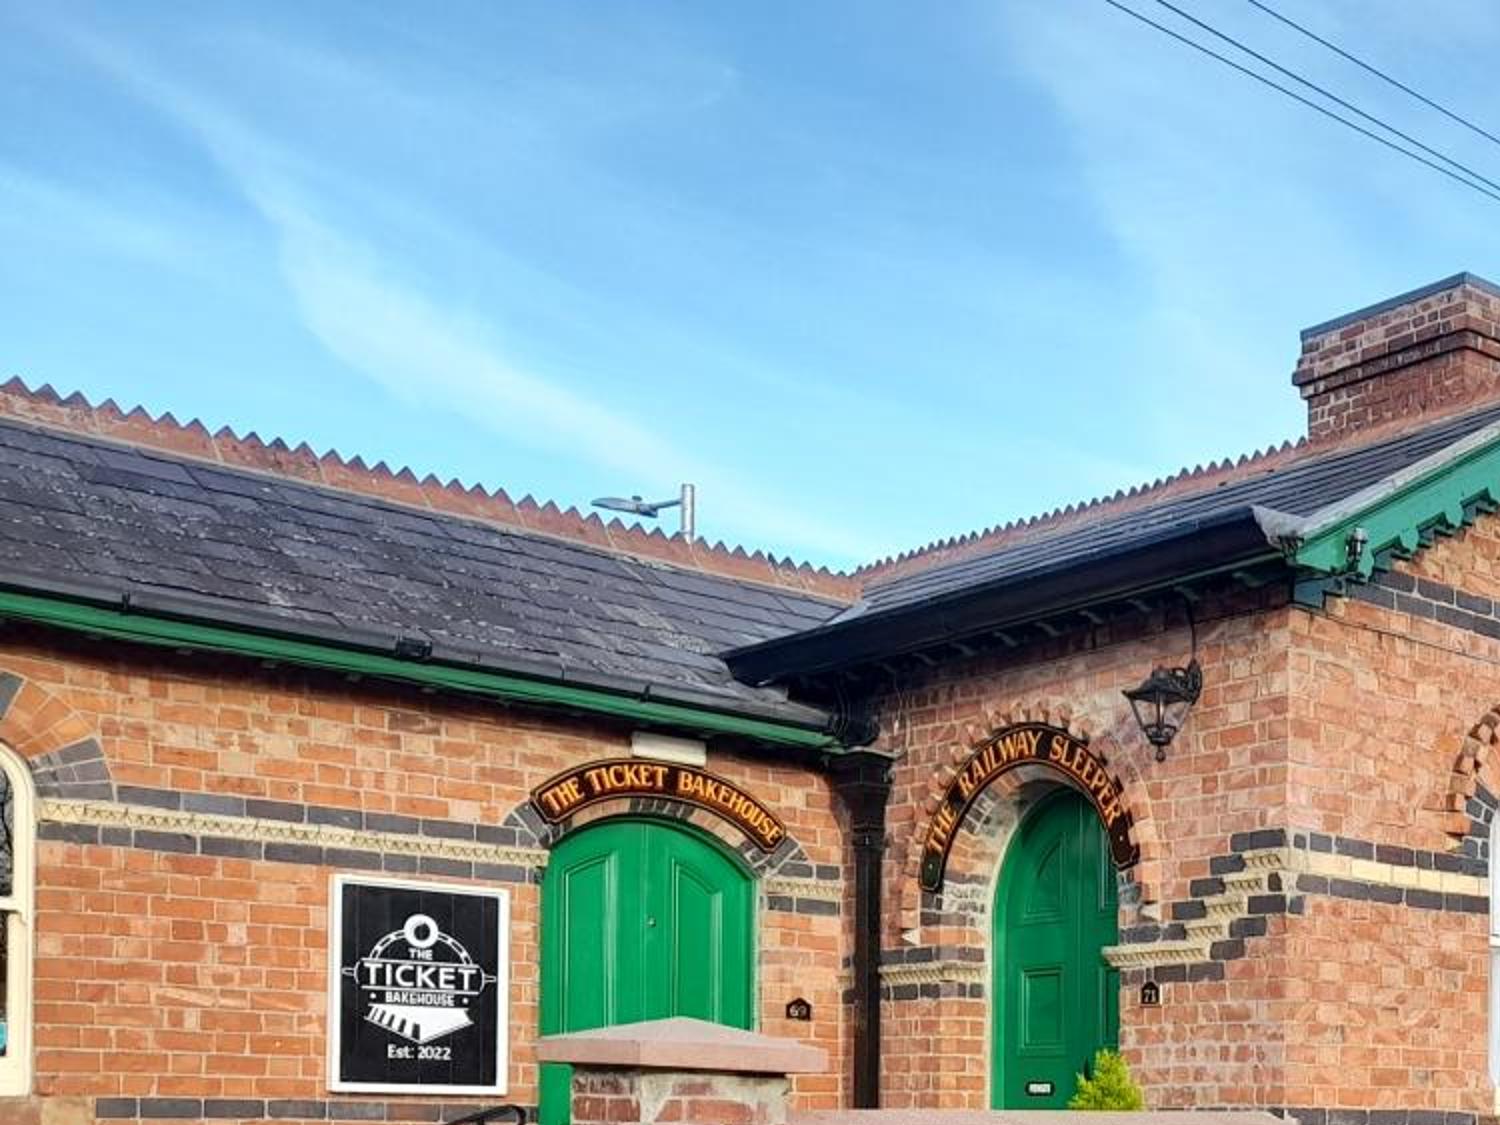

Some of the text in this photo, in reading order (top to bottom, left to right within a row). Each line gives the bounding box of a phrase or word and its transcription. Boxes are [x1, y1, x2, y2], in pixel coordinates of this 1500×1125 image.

[926, 730, 1123, 852] THE RAILWAY SLEEPER
[542, 763, 784, 844] THE TICKET BAKEHOUSE
[408, 948, 433, 961] THE
[363, 962, 477, 991] TICKET
[385, 991, 455, 1007] BAKEHOUSE
[1143, 989, 1157, 1003] 71
[417, 1045, 452, 1061] 2022
